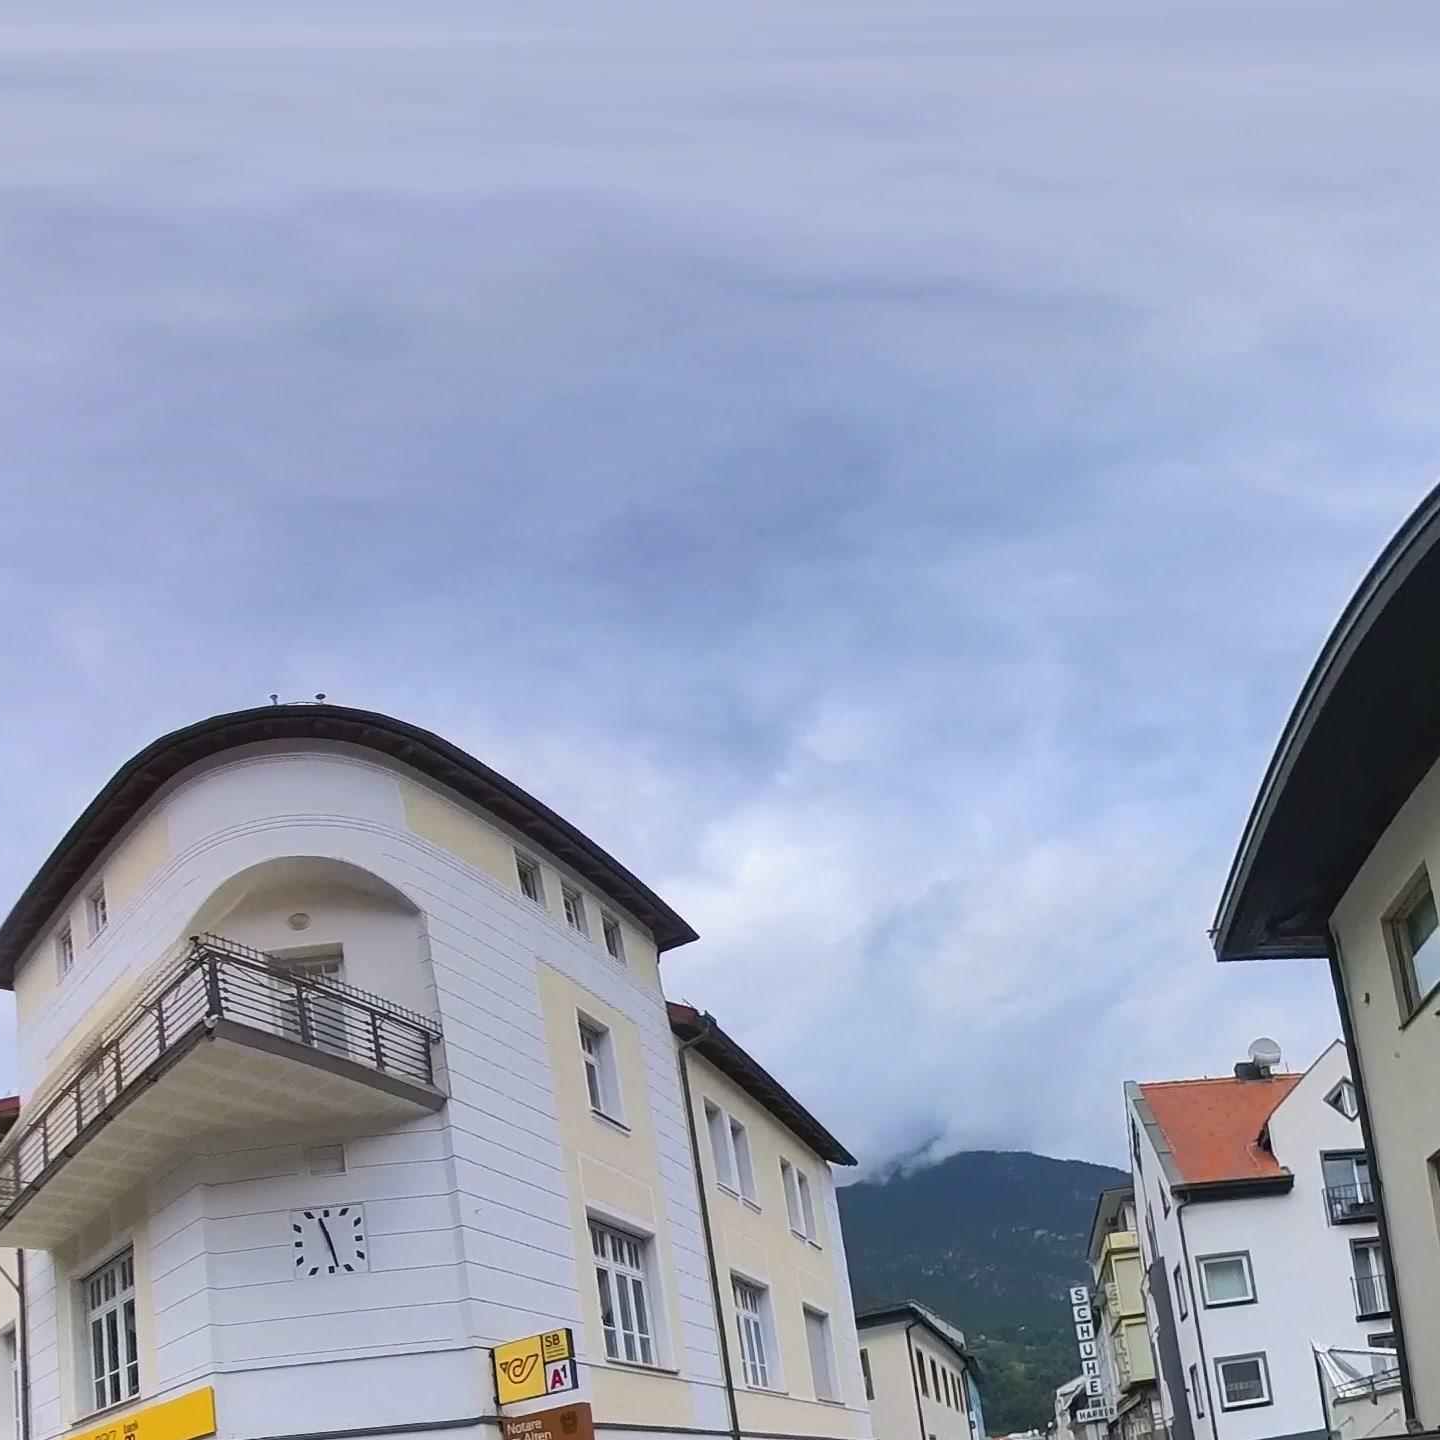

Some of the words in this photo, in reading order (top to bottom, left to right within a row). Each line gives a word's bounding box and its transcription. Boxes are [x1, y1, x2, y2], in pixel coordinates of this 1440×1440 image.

[544, 1333, 561, 1347] SB
[1074, 1288, 1099, 1394] SCHUHE
[551, 1364, 568, 1390] A1
[507, 1419, 542, 1435] Notare
